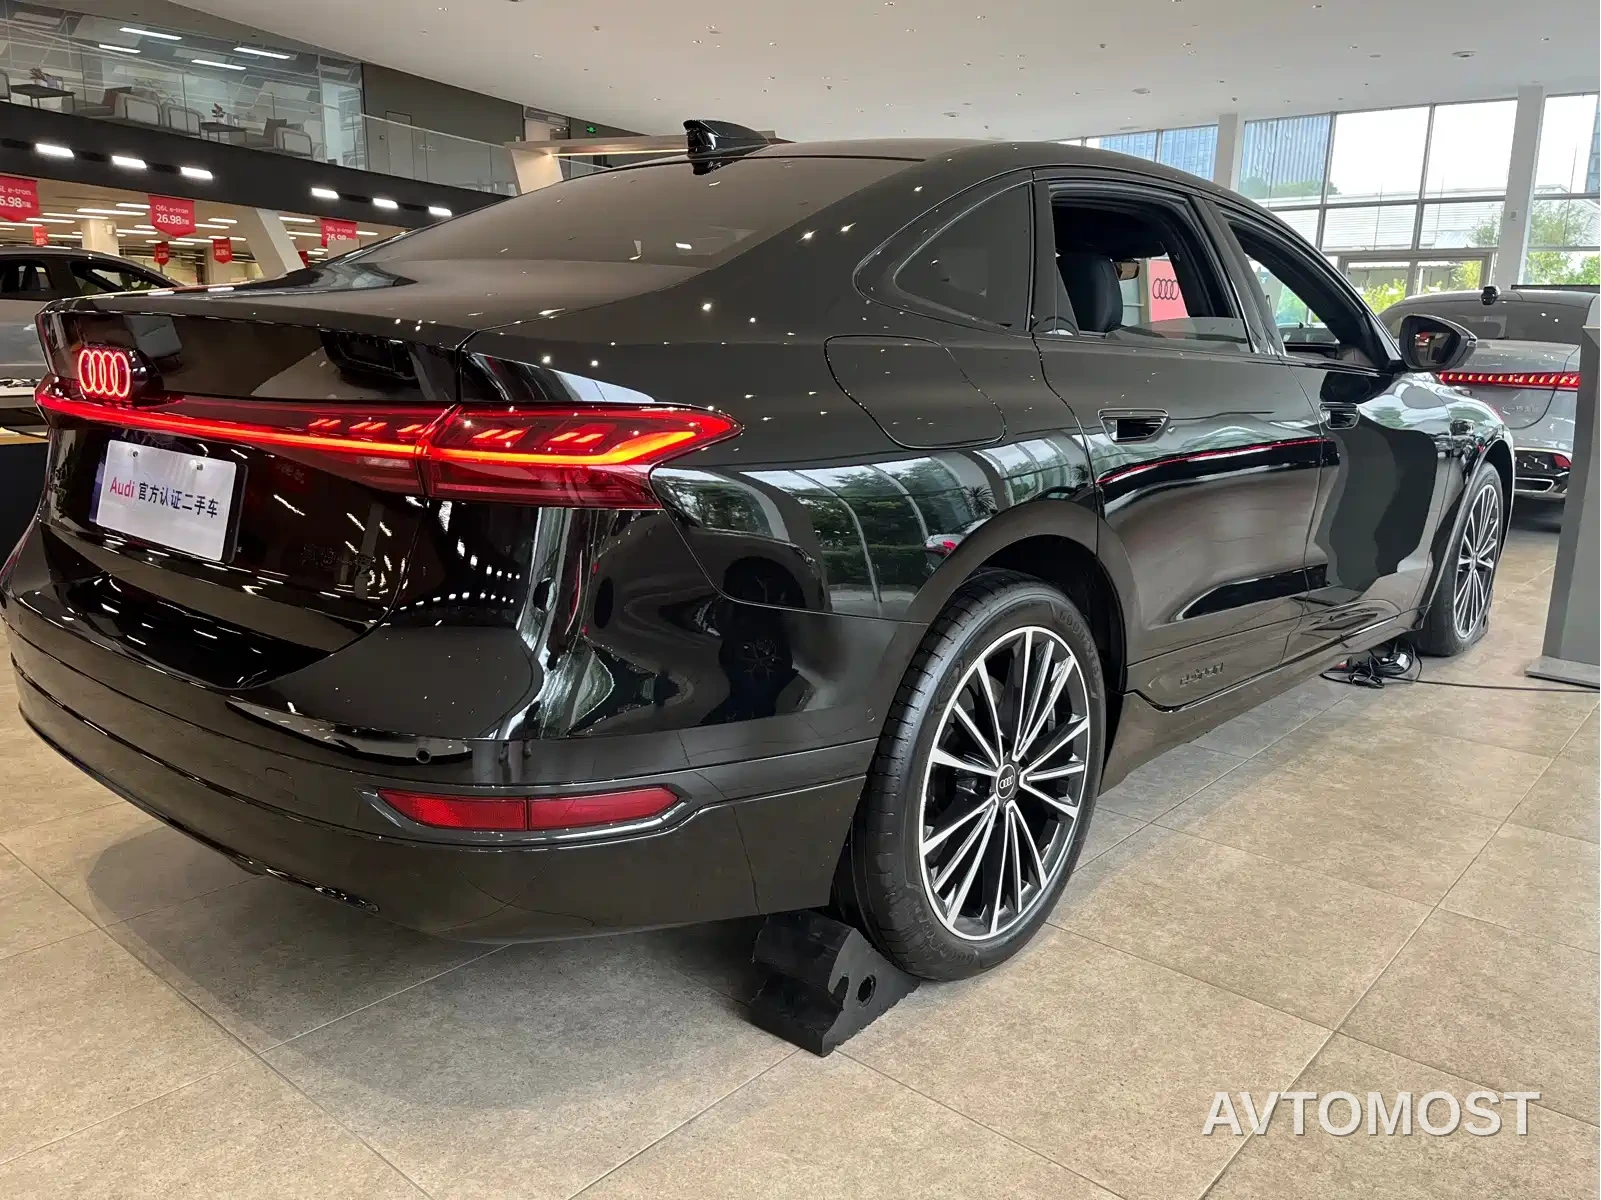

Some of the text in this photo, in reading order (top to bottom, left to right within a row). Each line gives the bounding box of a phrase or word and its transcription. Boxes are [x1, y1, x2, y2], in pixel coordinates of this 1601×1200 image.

[169, 207, 189, 215] e-tron
[109, 477, 219, 518] Audi 官方认证二手车
